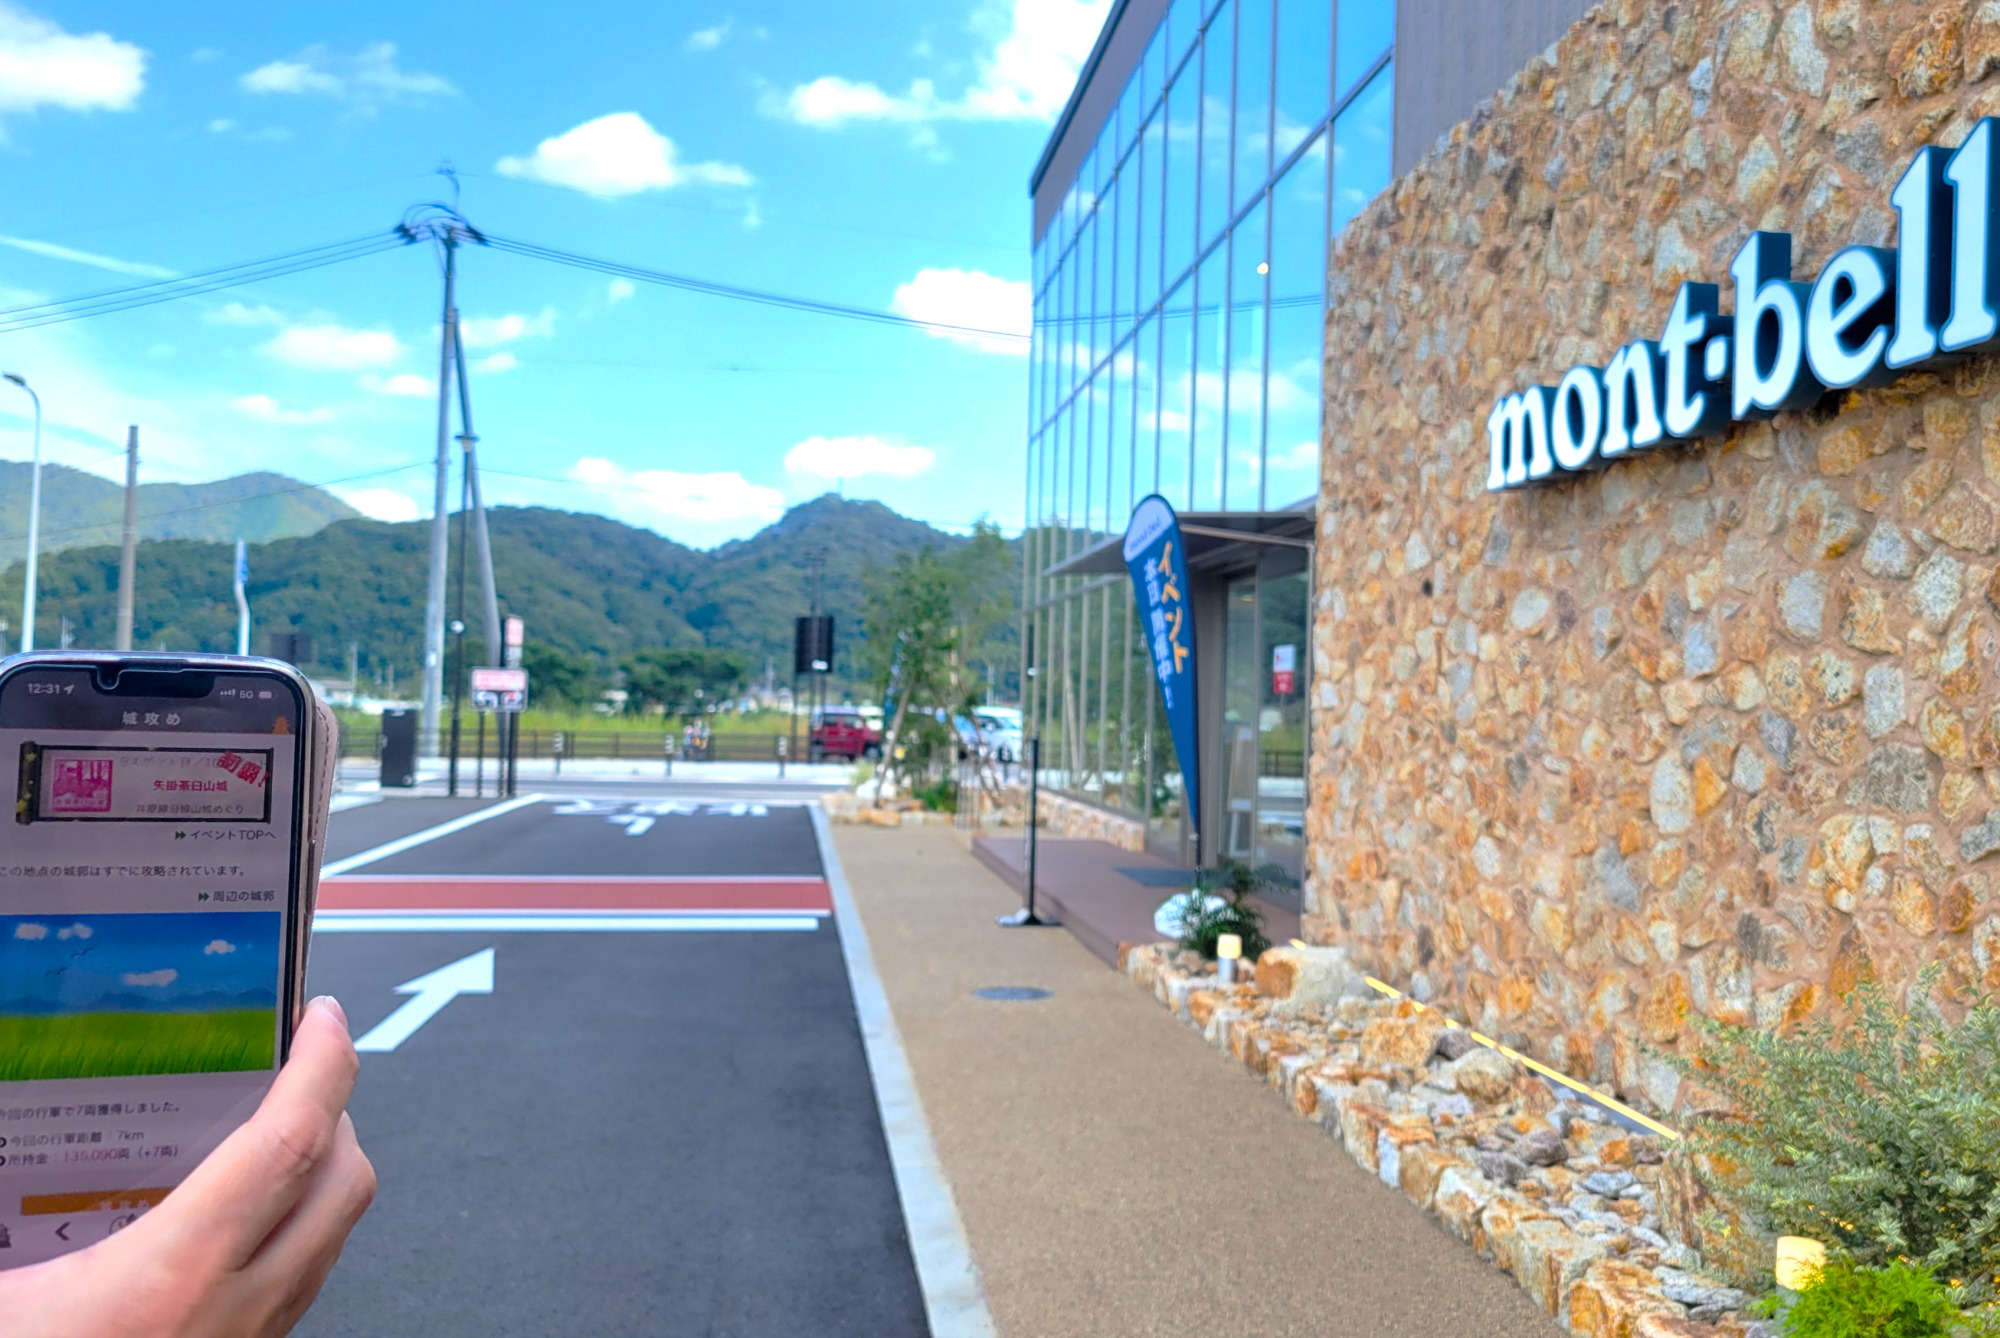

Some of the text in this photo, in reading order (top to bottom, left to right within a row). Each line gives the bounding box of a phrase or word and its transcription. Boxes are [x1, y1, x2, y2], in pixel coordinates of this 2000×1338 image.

[1158, 541, 1189, 674] イベント
[27, 682, 60, 695] 12:31
[239, 689, 254, 700] 5G
[122, 711, 181, 726] 城攻め
[190, 830, 276, 841] イベントTOPへ
[213, 890, 275, 902] 周辺の城郭
